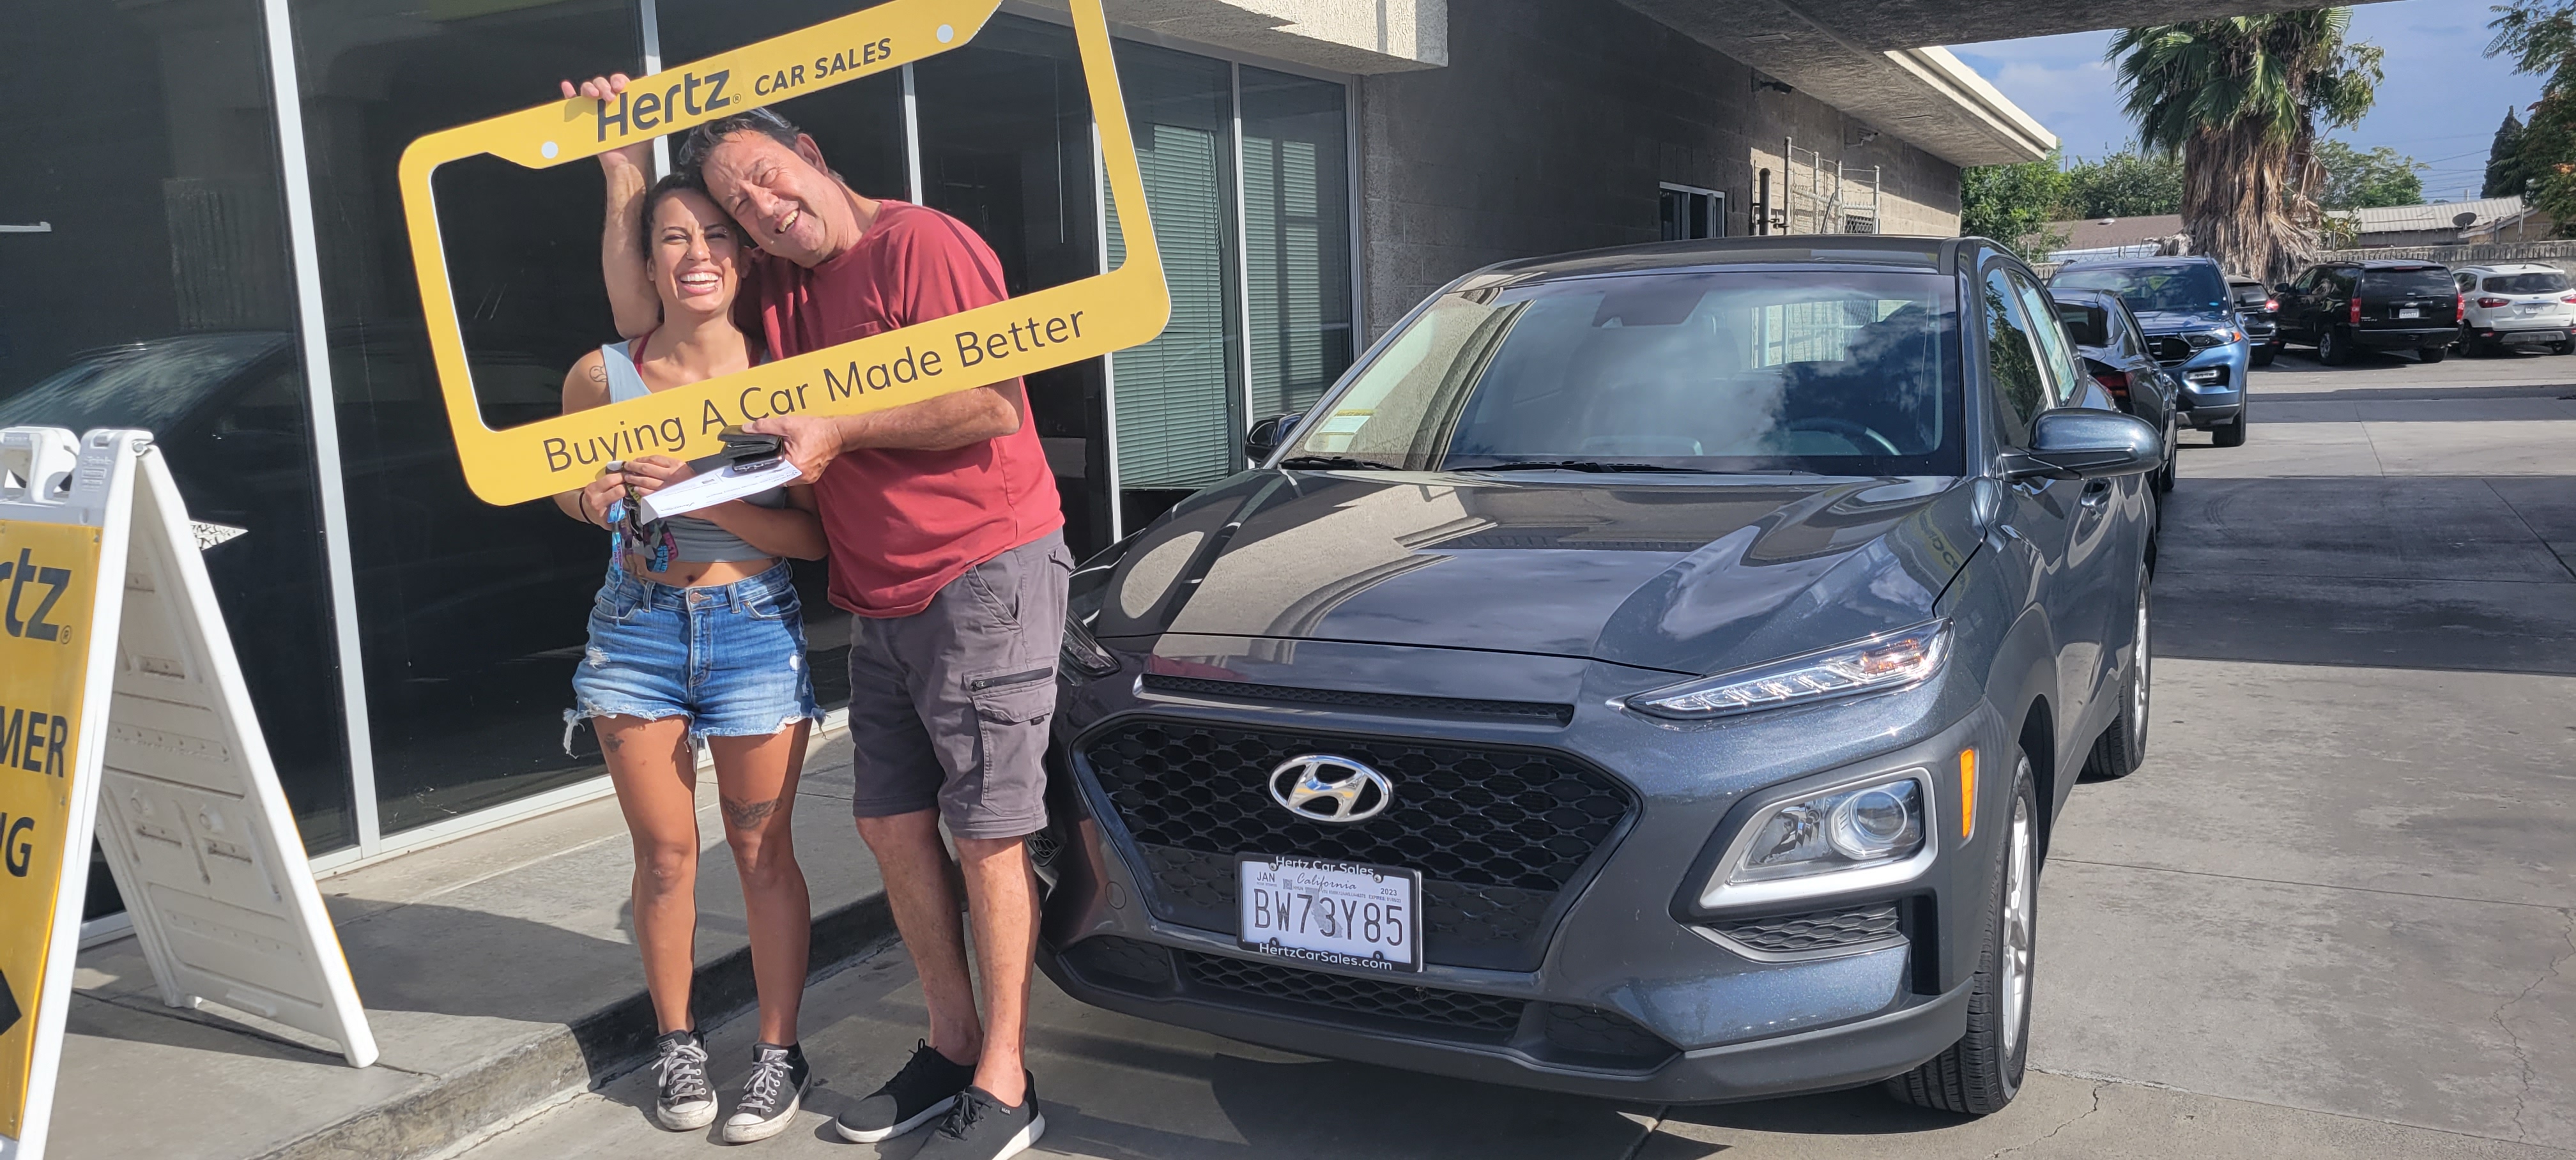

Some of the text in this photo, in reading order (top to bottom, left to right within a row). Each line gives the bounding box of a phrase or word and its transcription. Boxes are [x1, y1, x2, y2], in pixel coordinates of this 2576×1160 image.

[755, 38, 891, 96] CAR SALES
[597, 69, 730, 142] Hertz
[543, 310, 1085, 473] Buying A Car Made Better
[1257, 871, 1275, 883] JAN
[1276, 856, 1374, 876] Hertz Car Sales
[1297, 873, 1357, 893] California
[1380, 888, 1397, 896] 2023
[1254, 889, 1402, 946] BW73Y85
[1259, 943, 1392, 971] HertzCarSales.com
